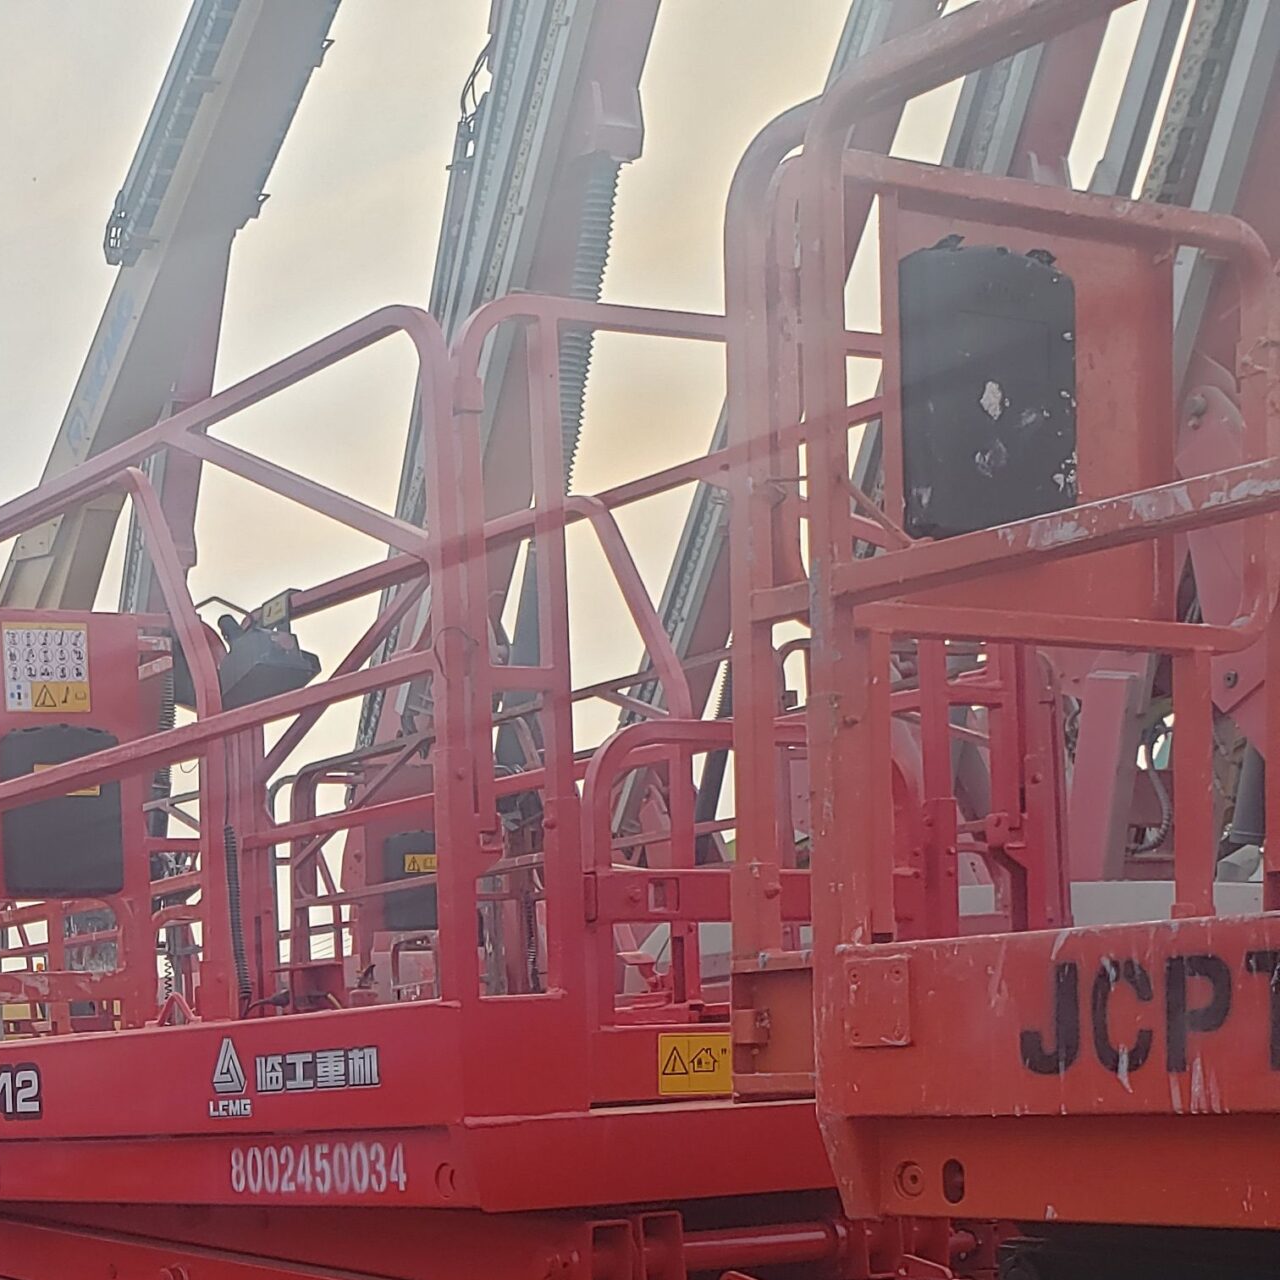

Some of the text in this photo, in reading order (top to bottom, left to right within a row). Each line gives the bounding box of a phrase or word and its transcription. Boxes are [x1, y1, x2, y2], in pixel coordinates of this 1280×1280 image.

[255, 1047, 380, 1092] 临工重机
[231, 1142, 407, 1194] 8002450034
